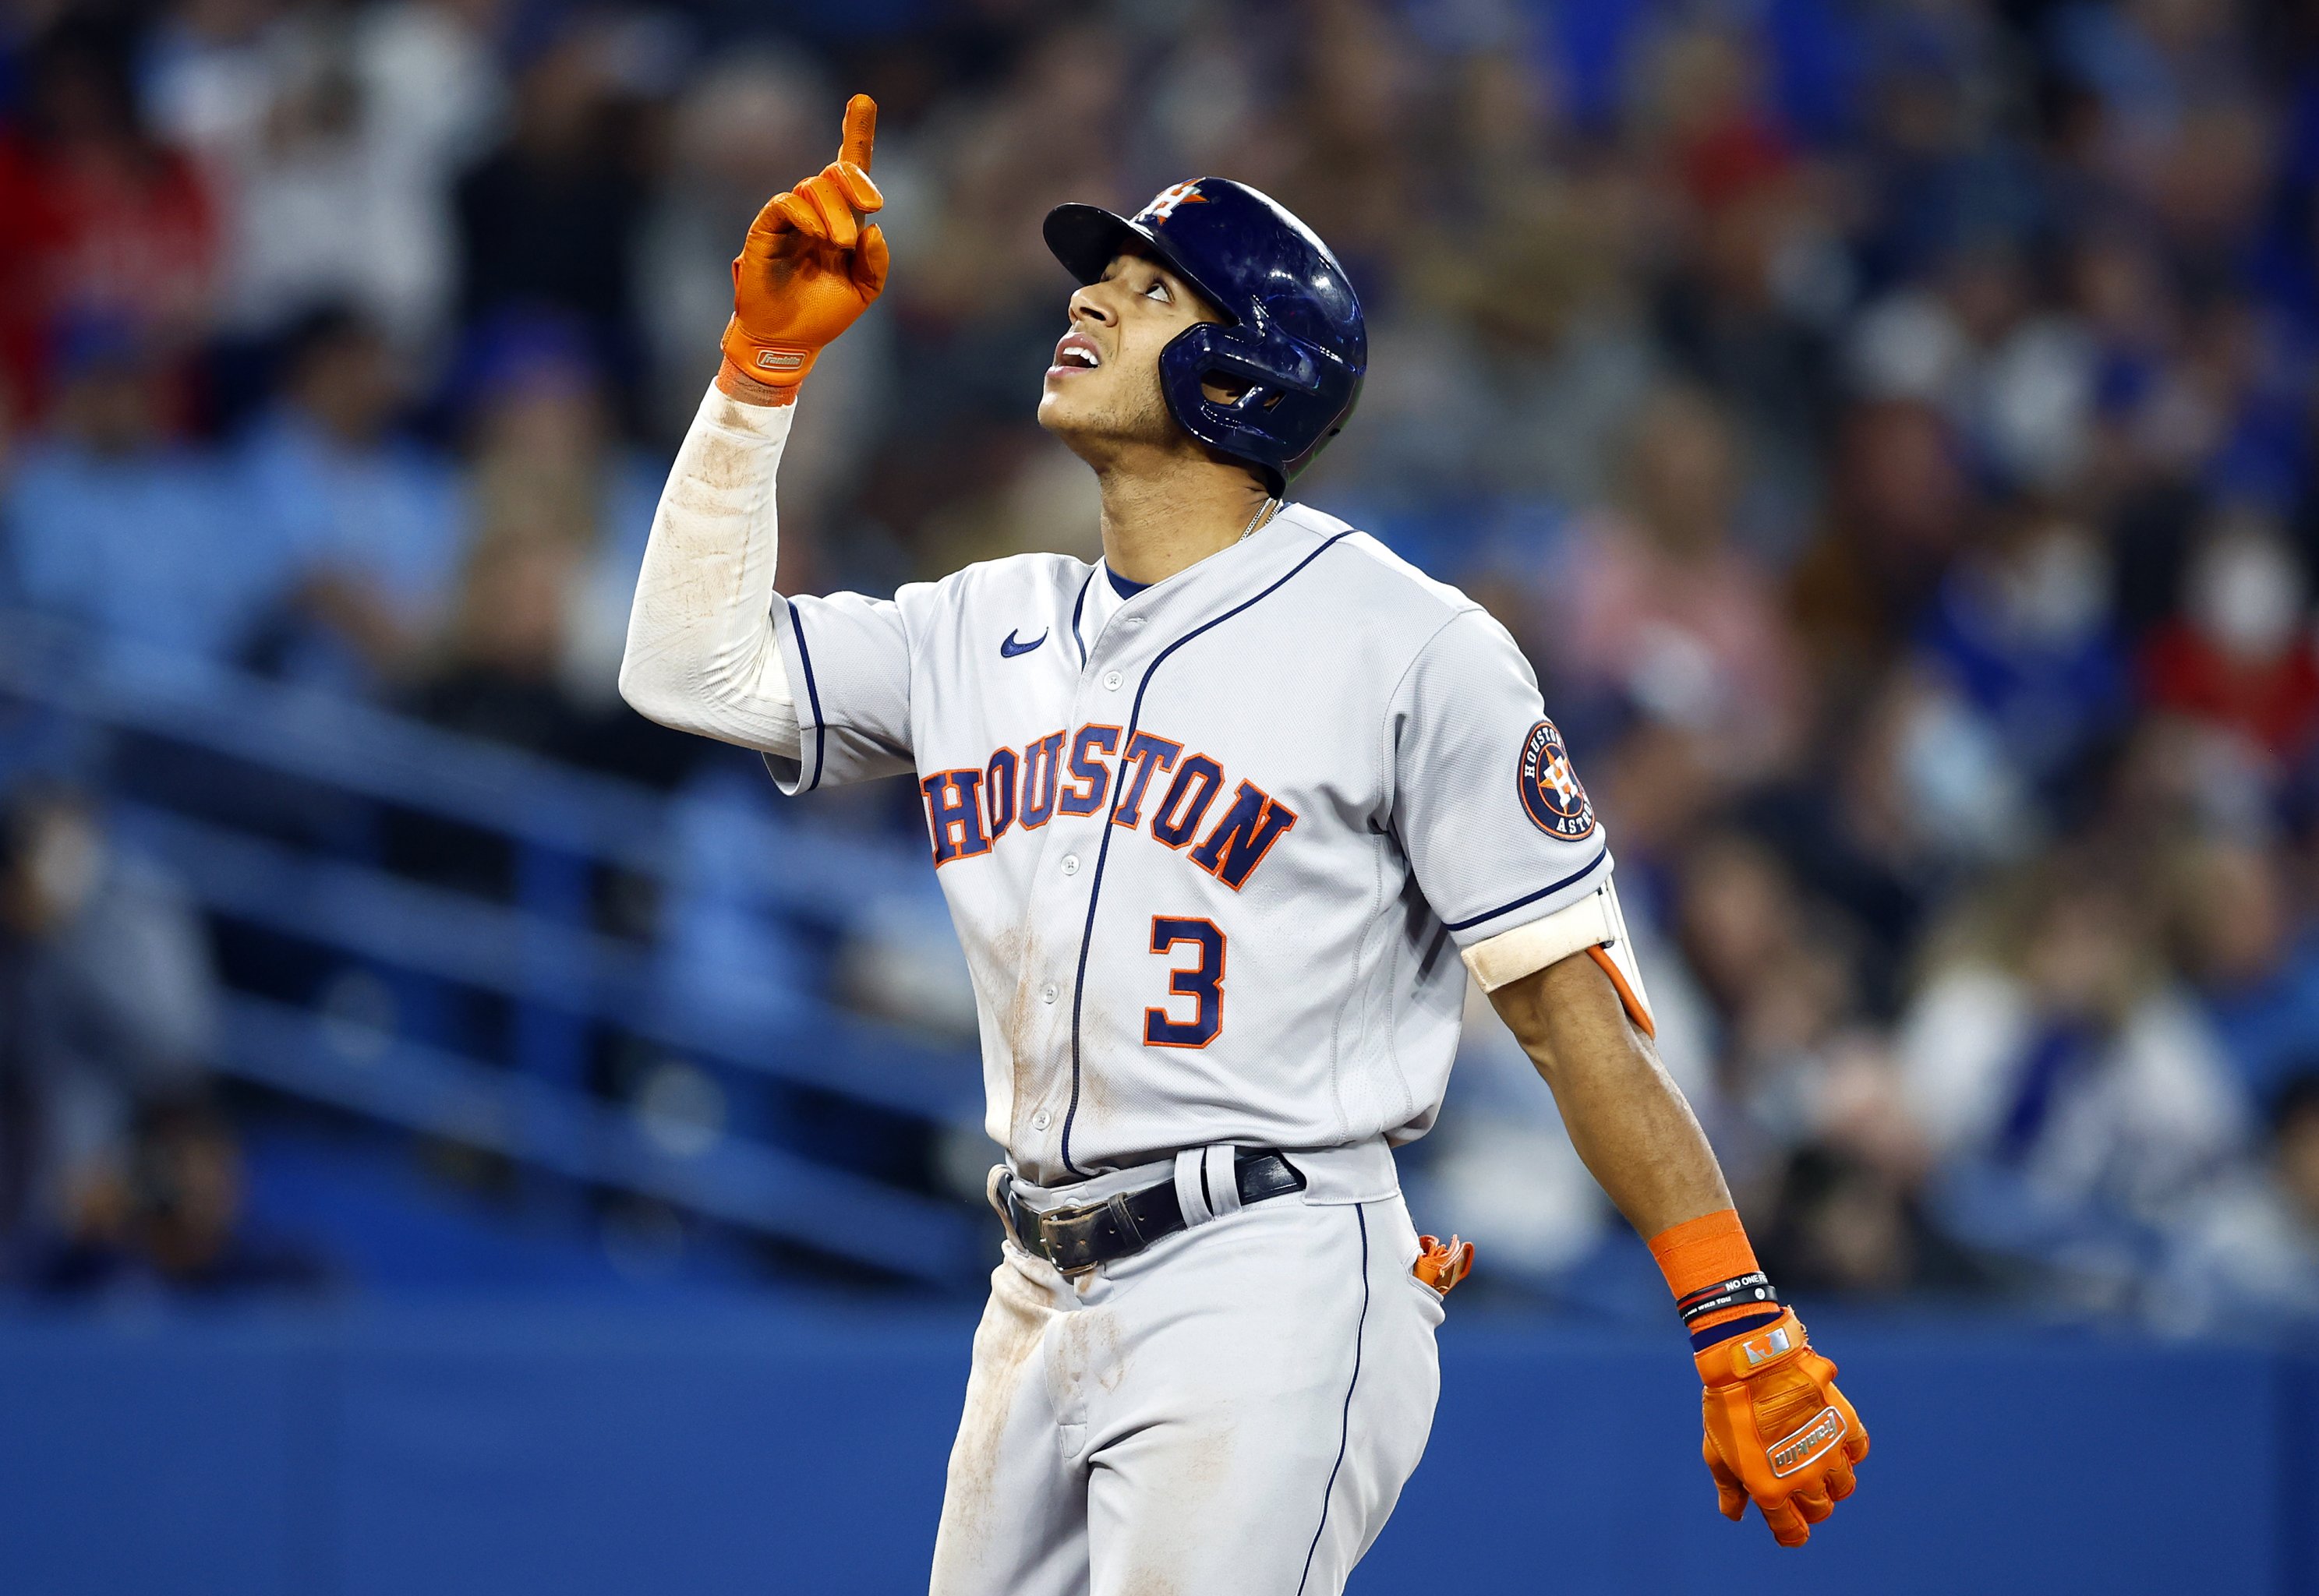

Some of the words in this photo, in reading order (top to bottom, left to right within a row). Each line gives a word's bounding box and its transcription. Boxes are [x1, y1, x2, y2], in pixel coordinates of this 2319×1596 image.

[921, 722, 1298, 892] HOUSTON
[1543, 755, 1578, 808] H
[1144, 914, 1227, 1049] 3
[1725, 1280, 1741, 1291] NO
[1741, 1275, 1759, 1286] ONE
